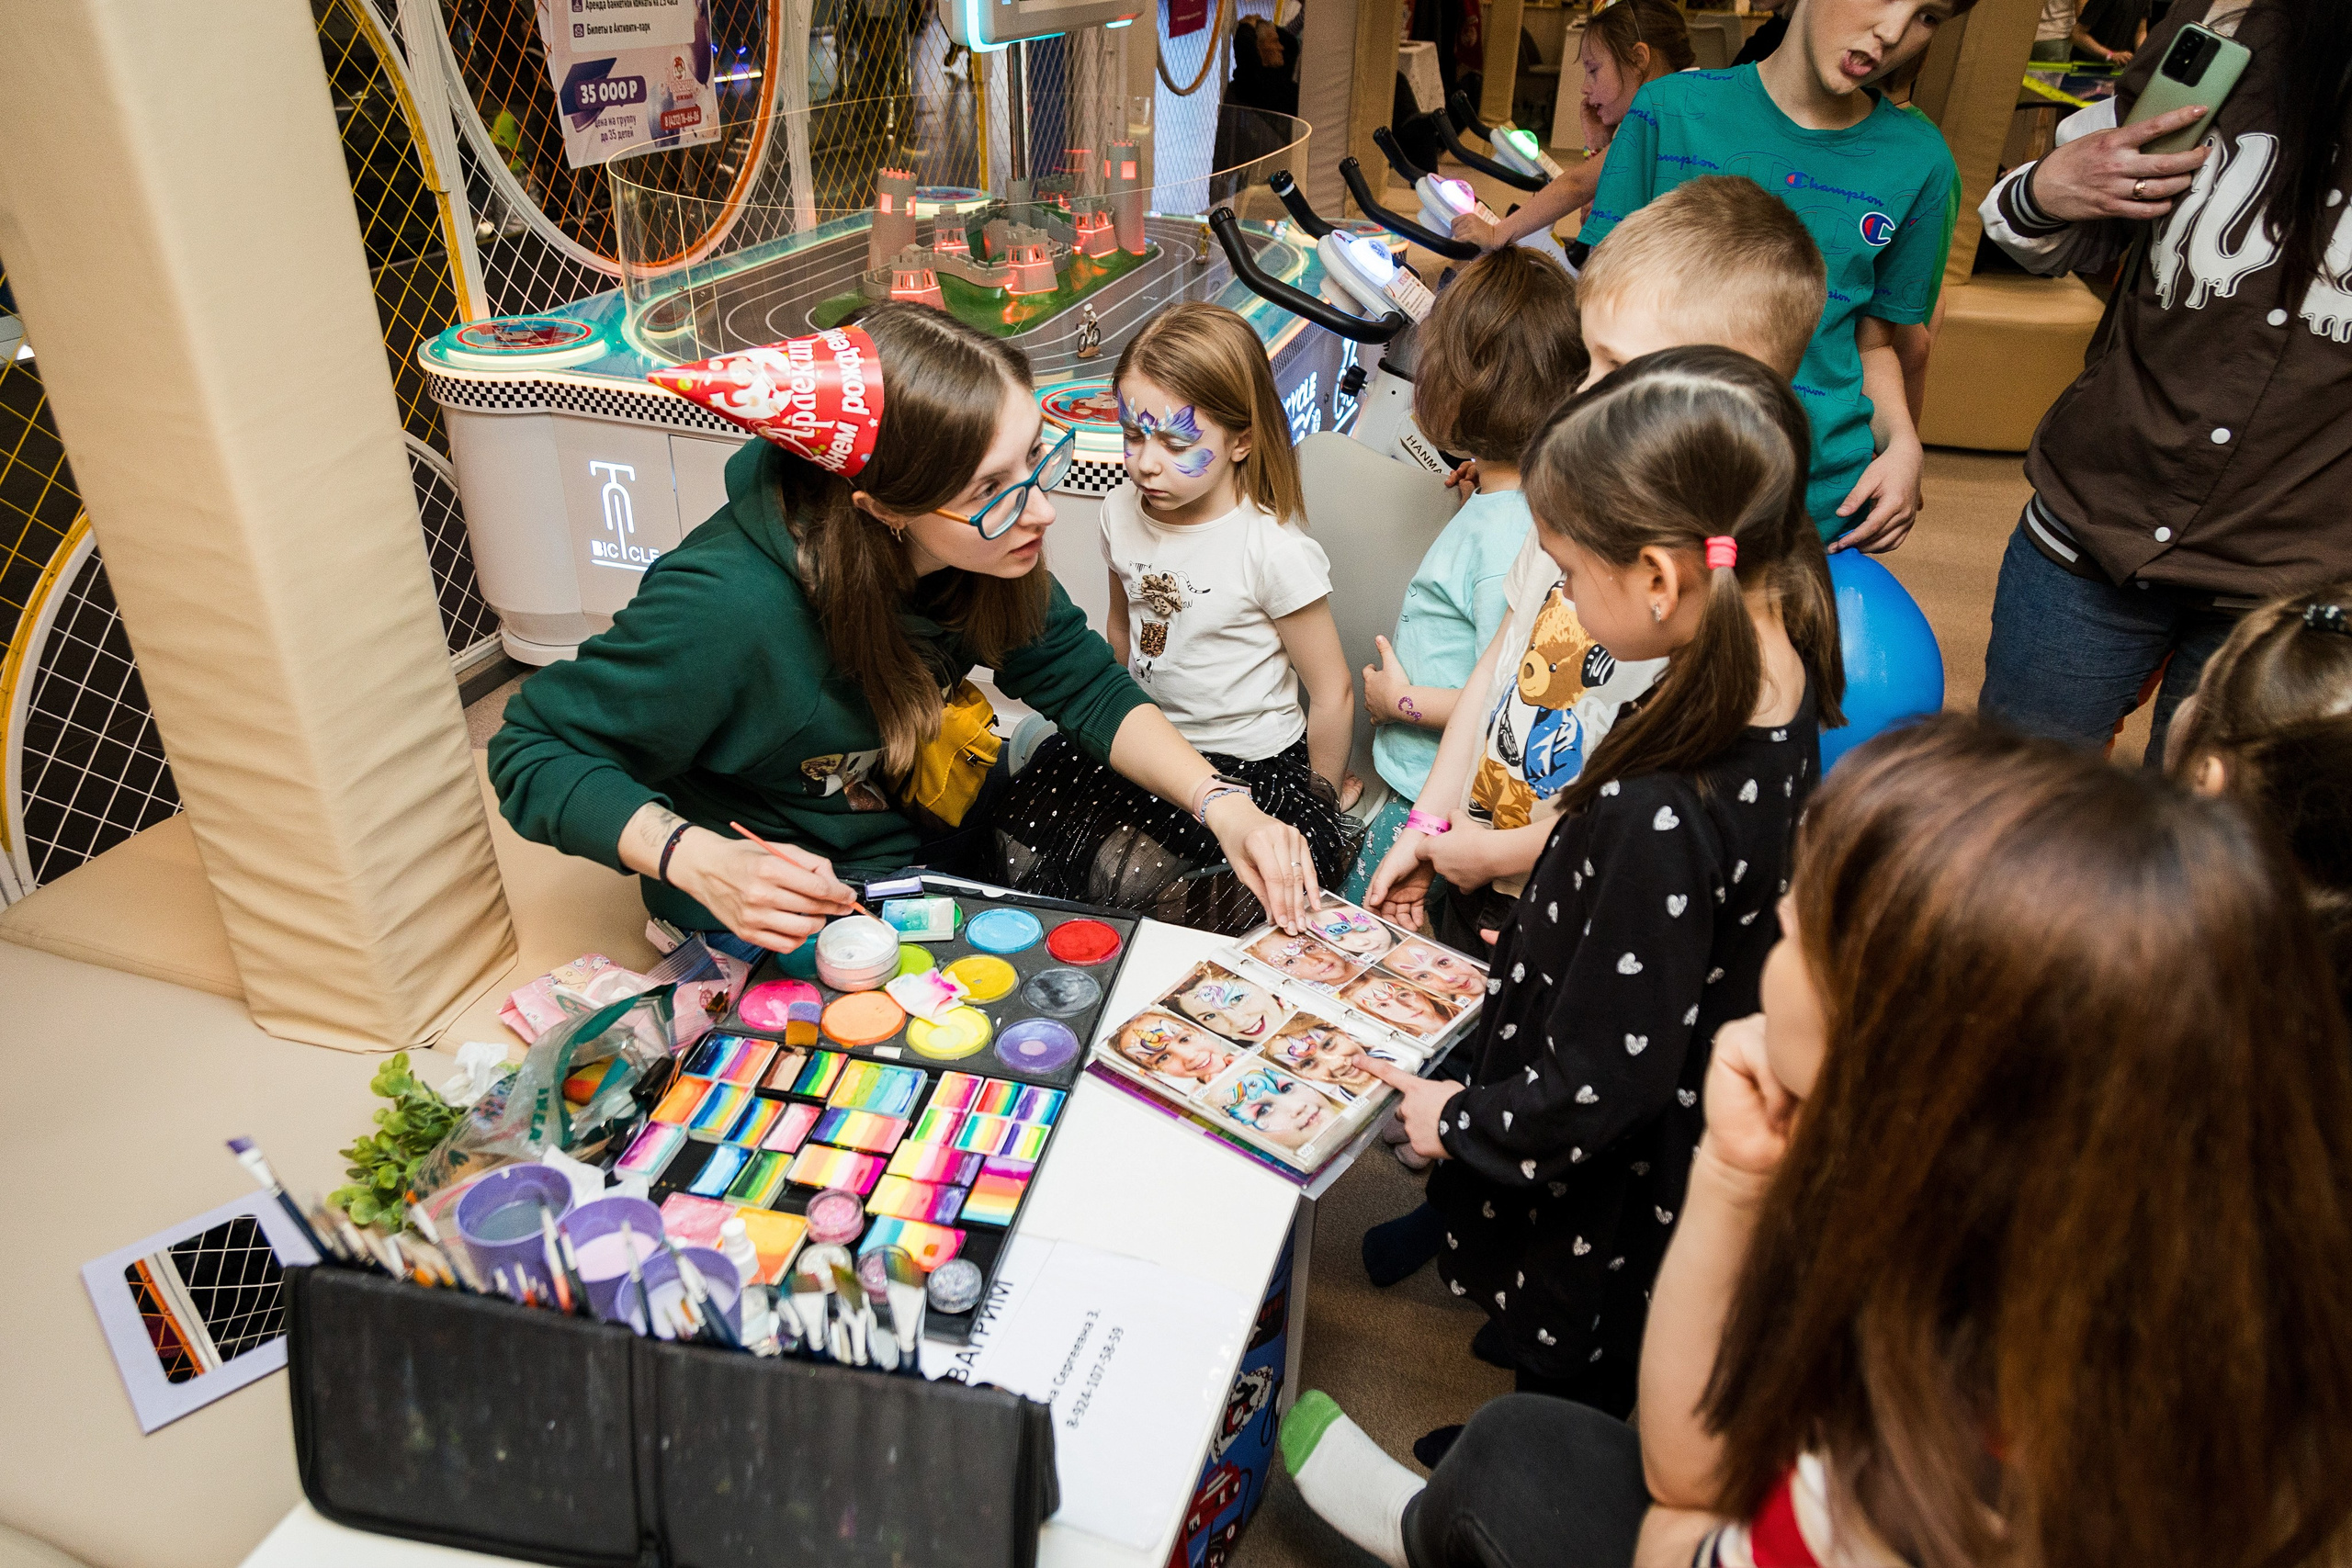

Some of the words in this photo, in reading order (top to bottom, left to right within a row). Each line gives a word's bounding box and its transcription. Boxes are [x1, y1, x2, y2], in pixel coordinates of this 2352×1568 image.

[586, 23, 608, 35] Билеты
[609, 26, 613, 34] в
[614, 22, 651, 34] Активити-парк
[580, 84, 597, 104] 35
[599, 81, 628, 102] 000
[595, 118, 607, 129] цена
[608, 117, 616, 126] на
[616, 115, 636, 128] группу
[601, 131, 608, 142] до
[608, 129, 616, 141] 35
[617, 126, 634, 141] детей
[1784, 171, 1885, 207] Champion
[527, 1087, 550, 1141] IKEA
[1053, 1321, 1094, 1386] Сергеевна
[1067, 1326, 1124, 1429] 8-924-107-58-59
